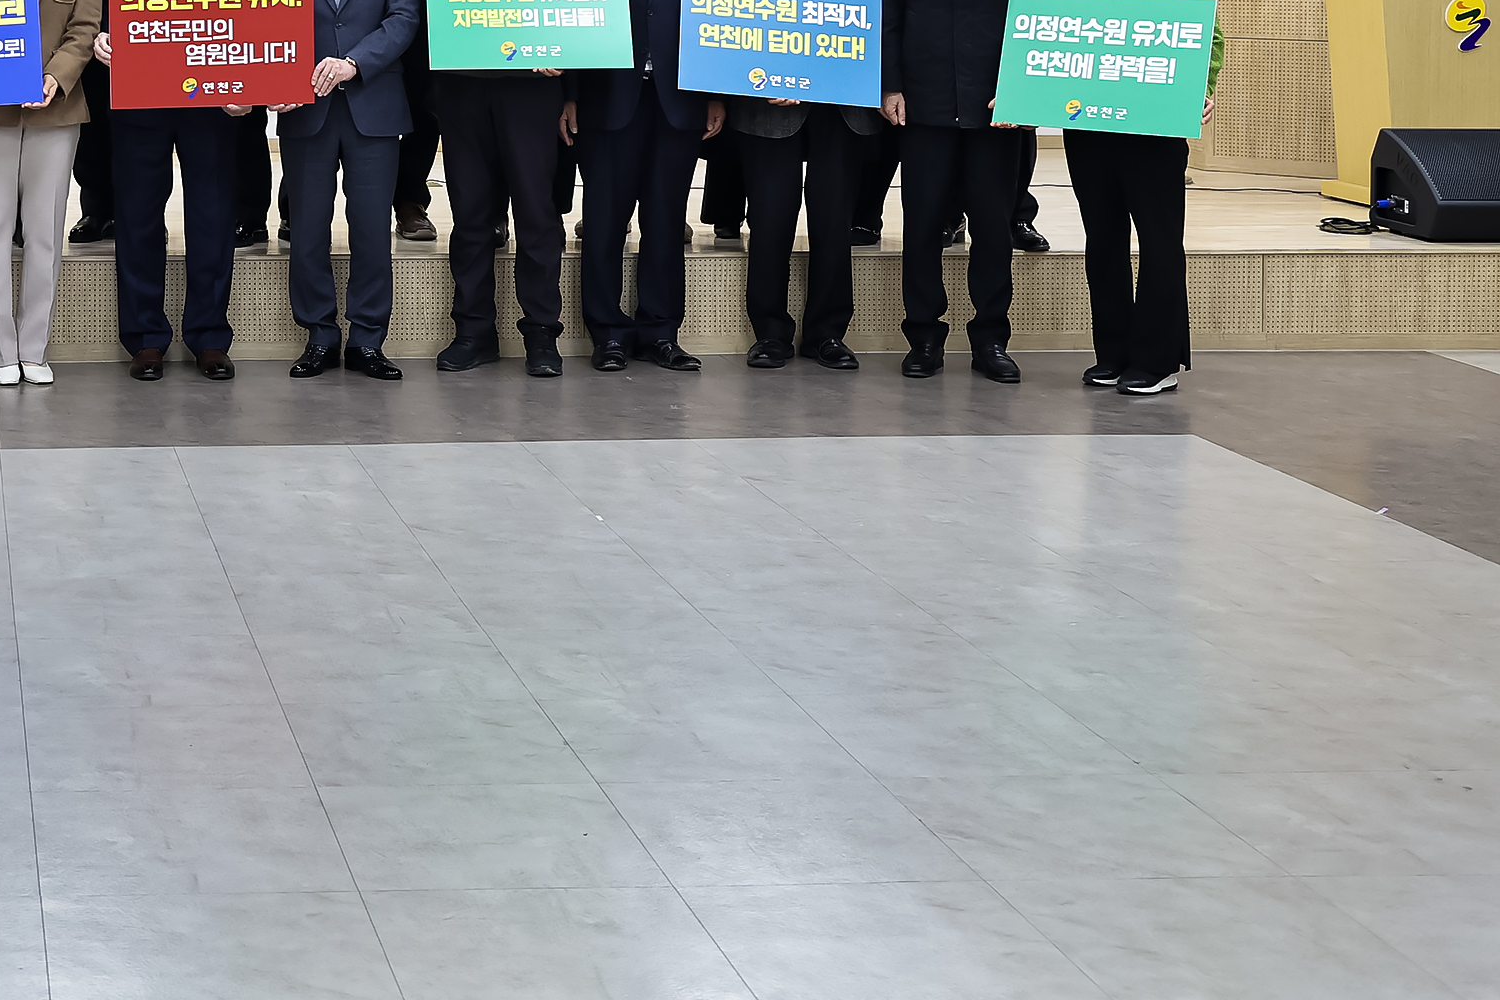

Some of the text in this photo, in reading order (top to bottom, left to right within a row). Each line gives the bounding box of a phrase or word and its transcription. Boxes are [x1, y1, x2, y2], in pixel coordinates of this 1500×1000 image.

[453, 7, 605, 28] 지역발전의 디딤돌!!
[801, 0, 872, 30] 최적지,
[128, 18, 234, 43] 연천군민의
[698, 23, 865, 61] 연천에 답이 있다!
[1013, 14, 1203, 49] 의정연수원 유치로
[185, 41, 296, 66] 염원입니다!
[520, 45, 562, 57] 연천군
[1025, 49, 1177, 85] 연천에 활력을!
[202, 81, 244, 94] 연천군
[769, 75, 811, 89] 연천군
[1085, 105, 1128, 120] 연천군
